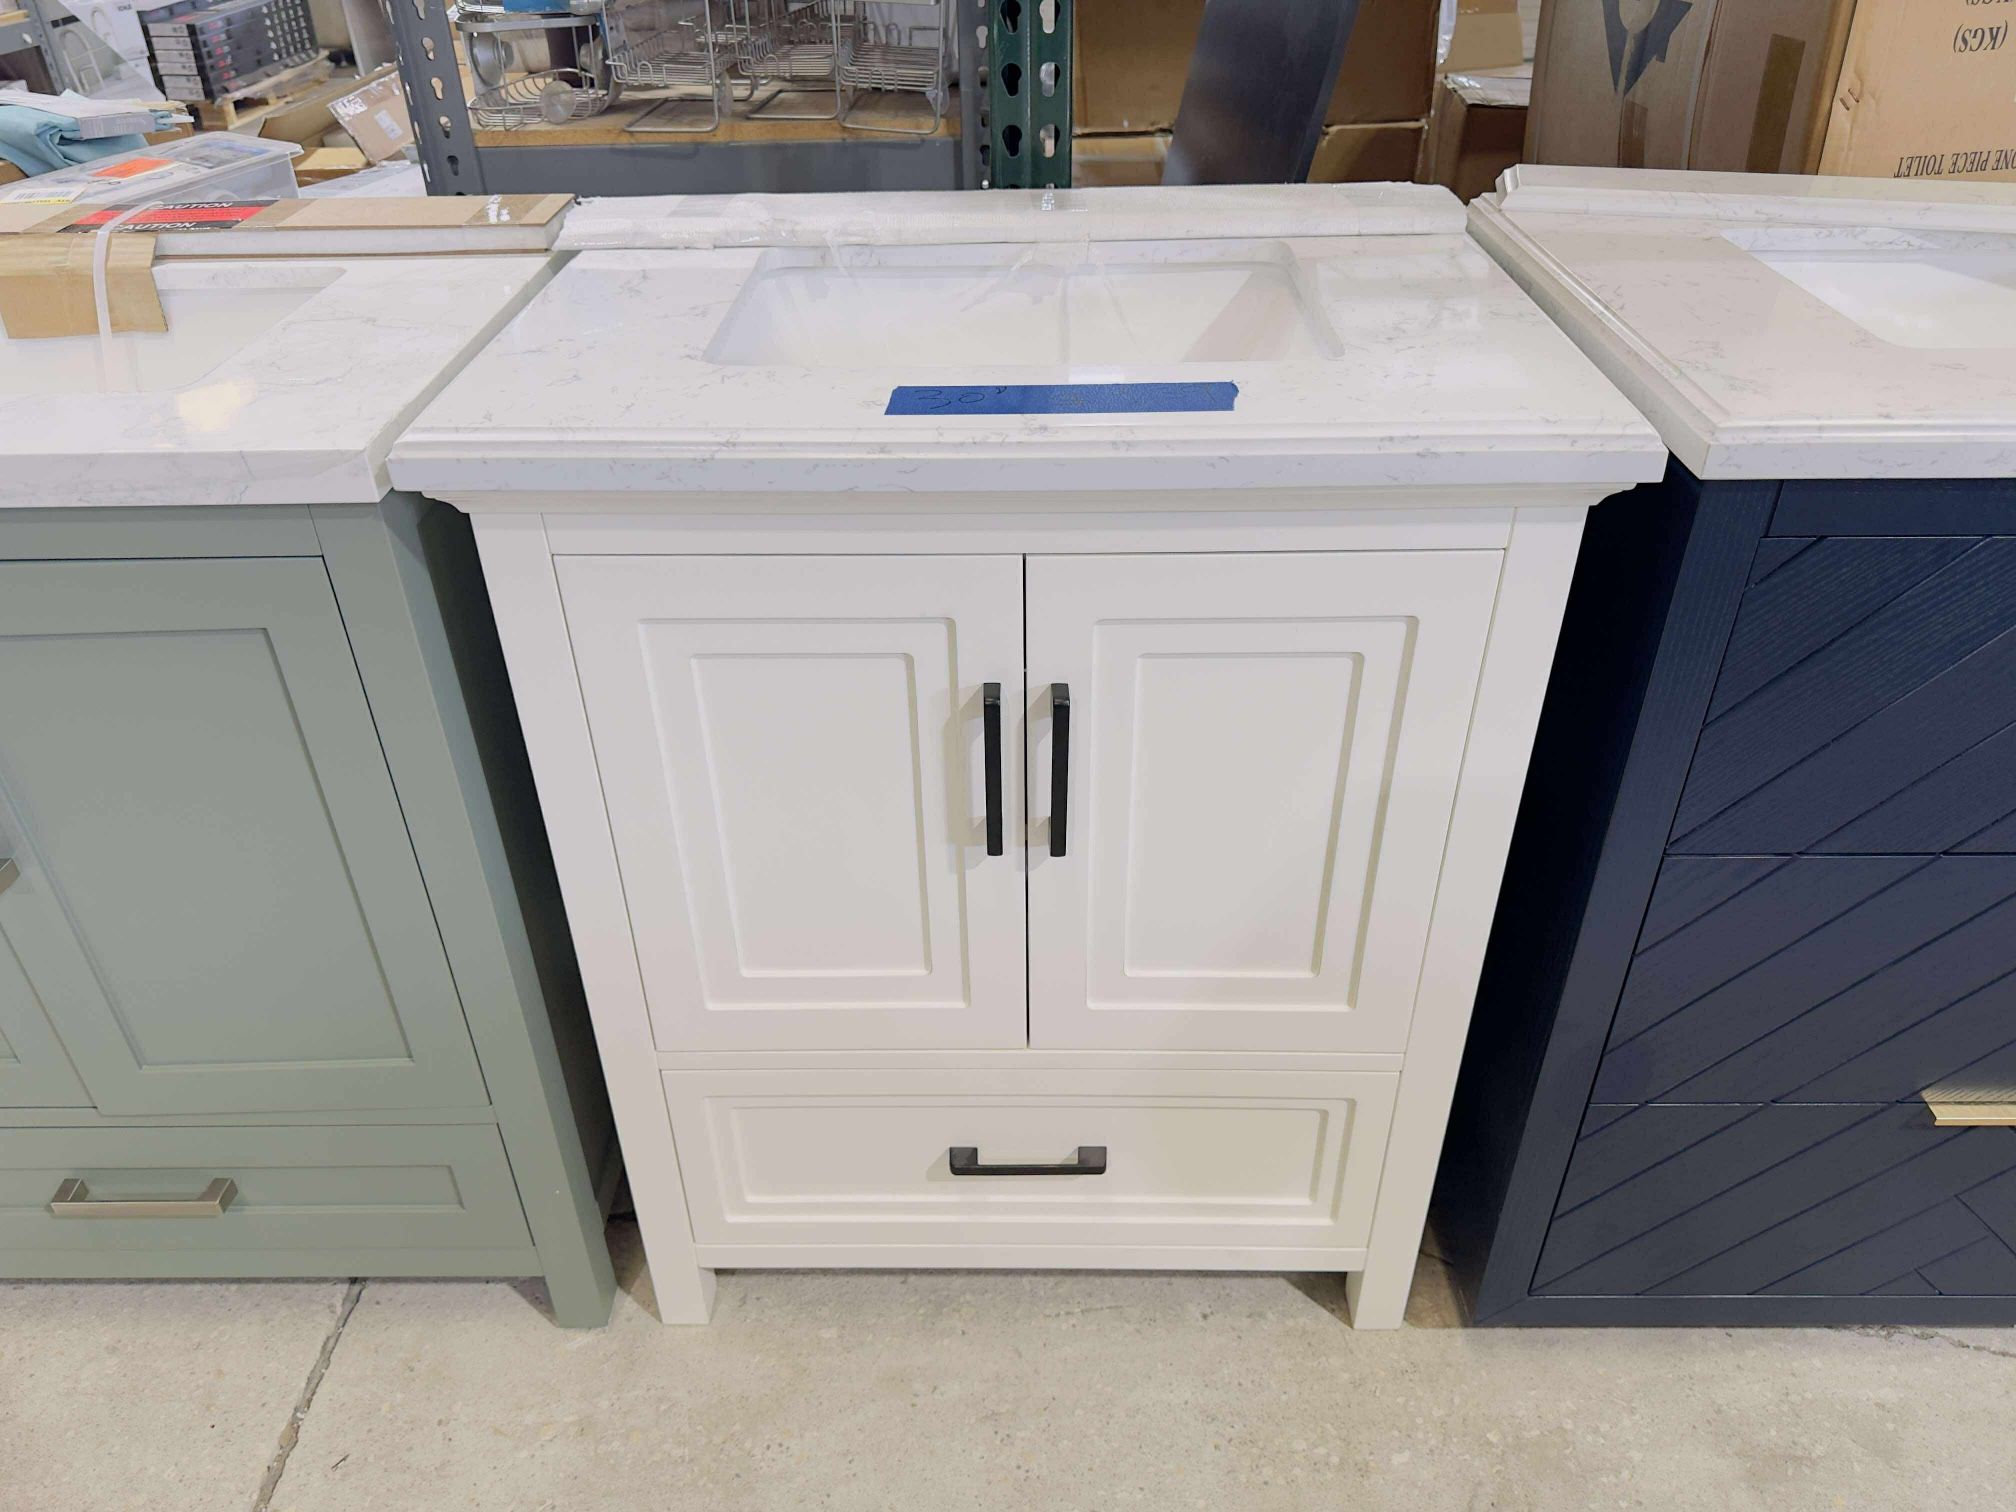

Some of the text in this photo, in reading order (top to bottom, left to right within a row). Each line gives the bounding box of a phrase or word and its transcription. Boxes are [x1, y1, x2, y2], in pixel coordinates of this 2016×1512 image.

[1953, 19, 2008, 53] (KGS)
[1893, 154, 1945, 178] TOILET
[1948, 150, 1992, 174] PIECE
